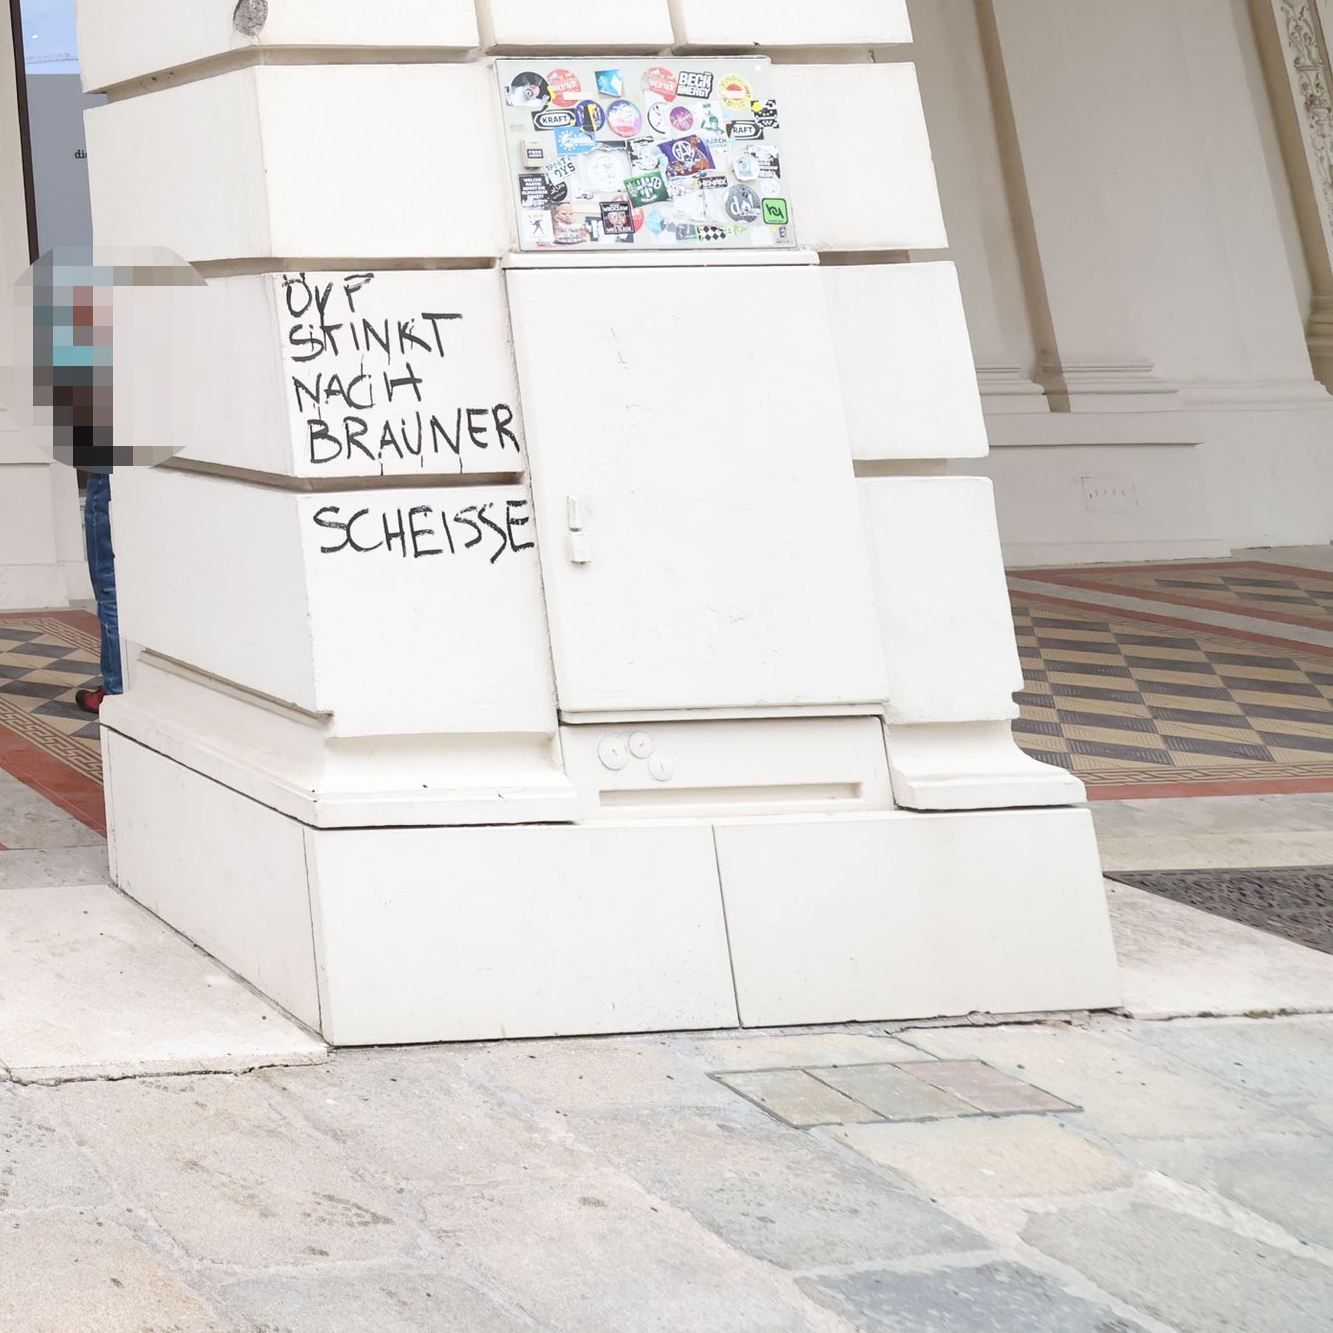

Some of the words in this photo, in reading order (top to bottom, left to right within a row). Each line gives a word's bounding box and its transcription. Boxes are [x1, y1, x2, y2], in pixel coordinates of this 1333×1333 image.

[542, 115, 567, 124] KRAFT
[733, 126, 753, 134] RAFT
[289, 312, 463, 363] STINKT
[292, 363, 423, 413] NACH
[307, 403, 520, 465] BRAUNER
[312, 499, 535, 564] SCHEISSE
